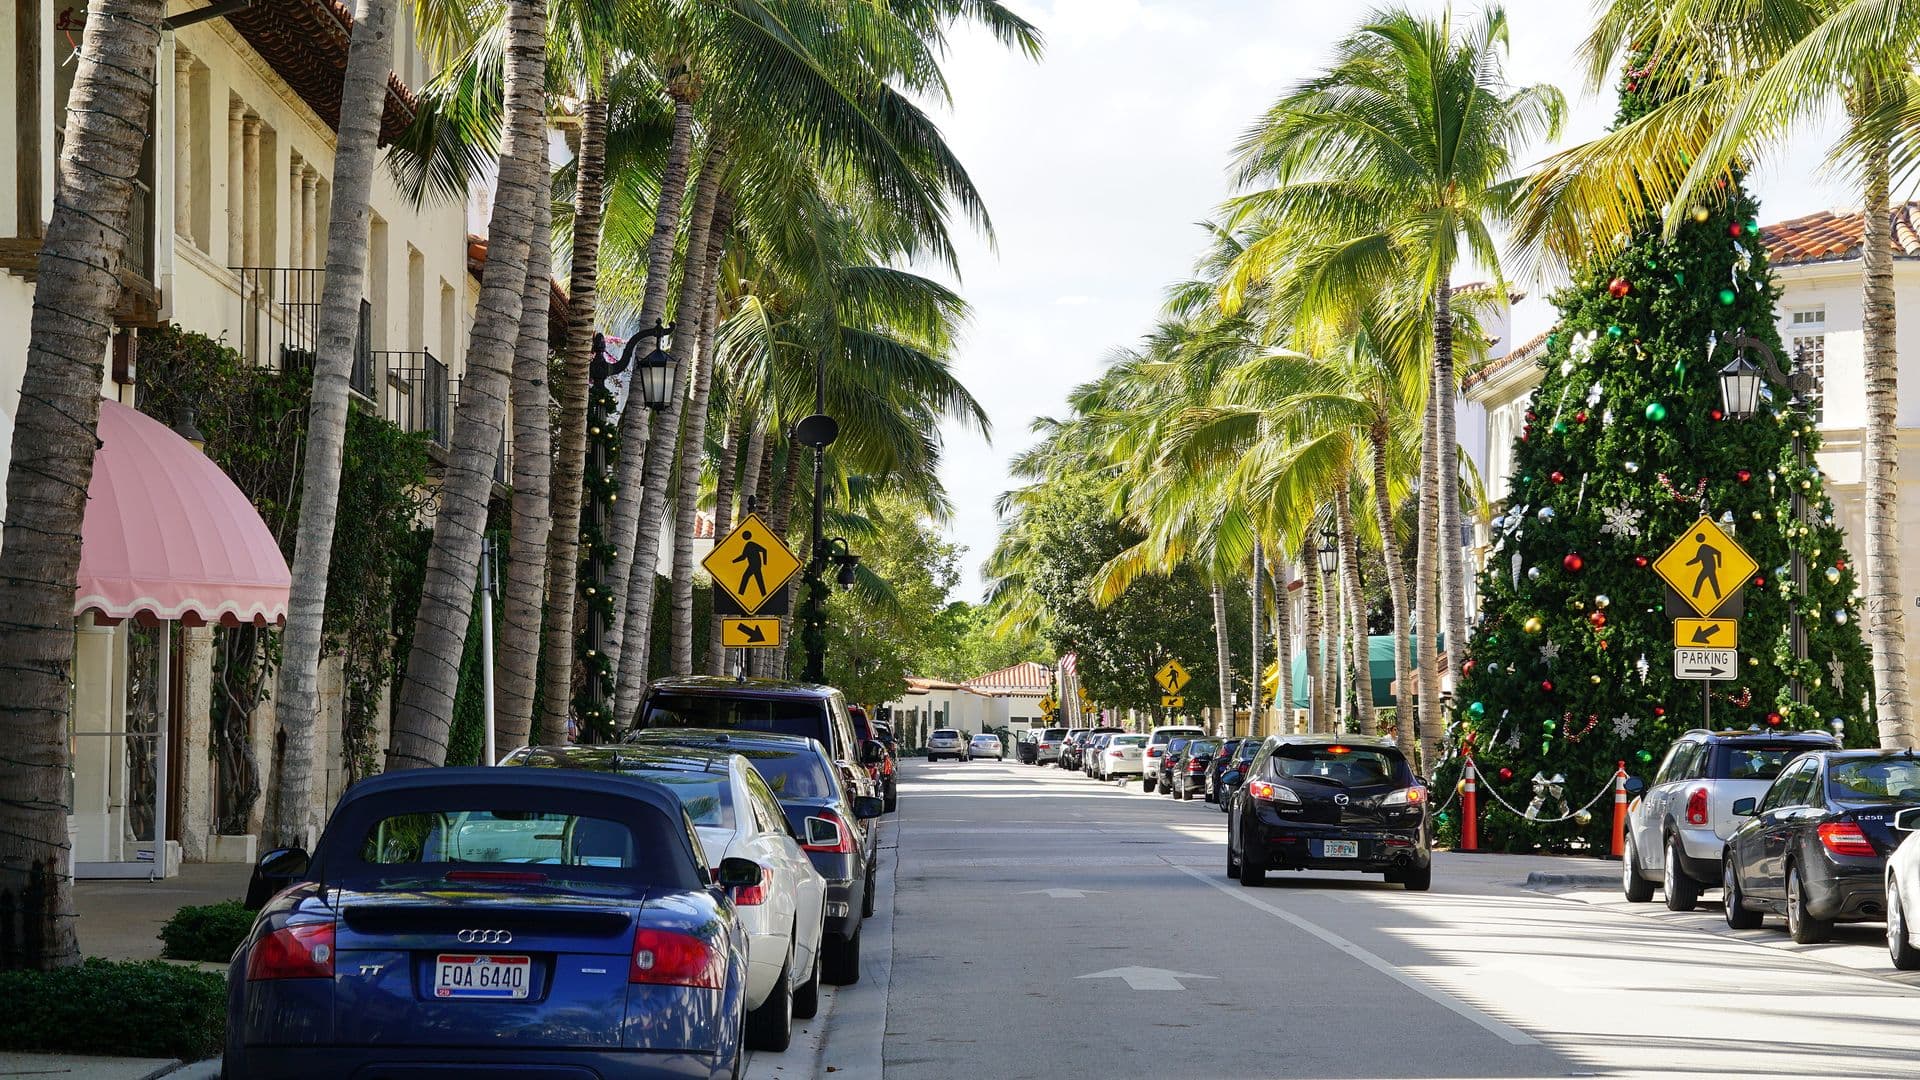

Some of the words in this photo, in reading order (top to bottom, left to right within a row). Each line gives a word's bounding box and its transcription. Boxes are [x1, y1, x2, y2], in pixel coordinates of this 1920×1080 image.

[1681, 651, 1728, 665] PARKING
[359, 964, 384, 976] TT
[441, 965, 473, 987] EQA
[480, 966, 522, 988] 6440
